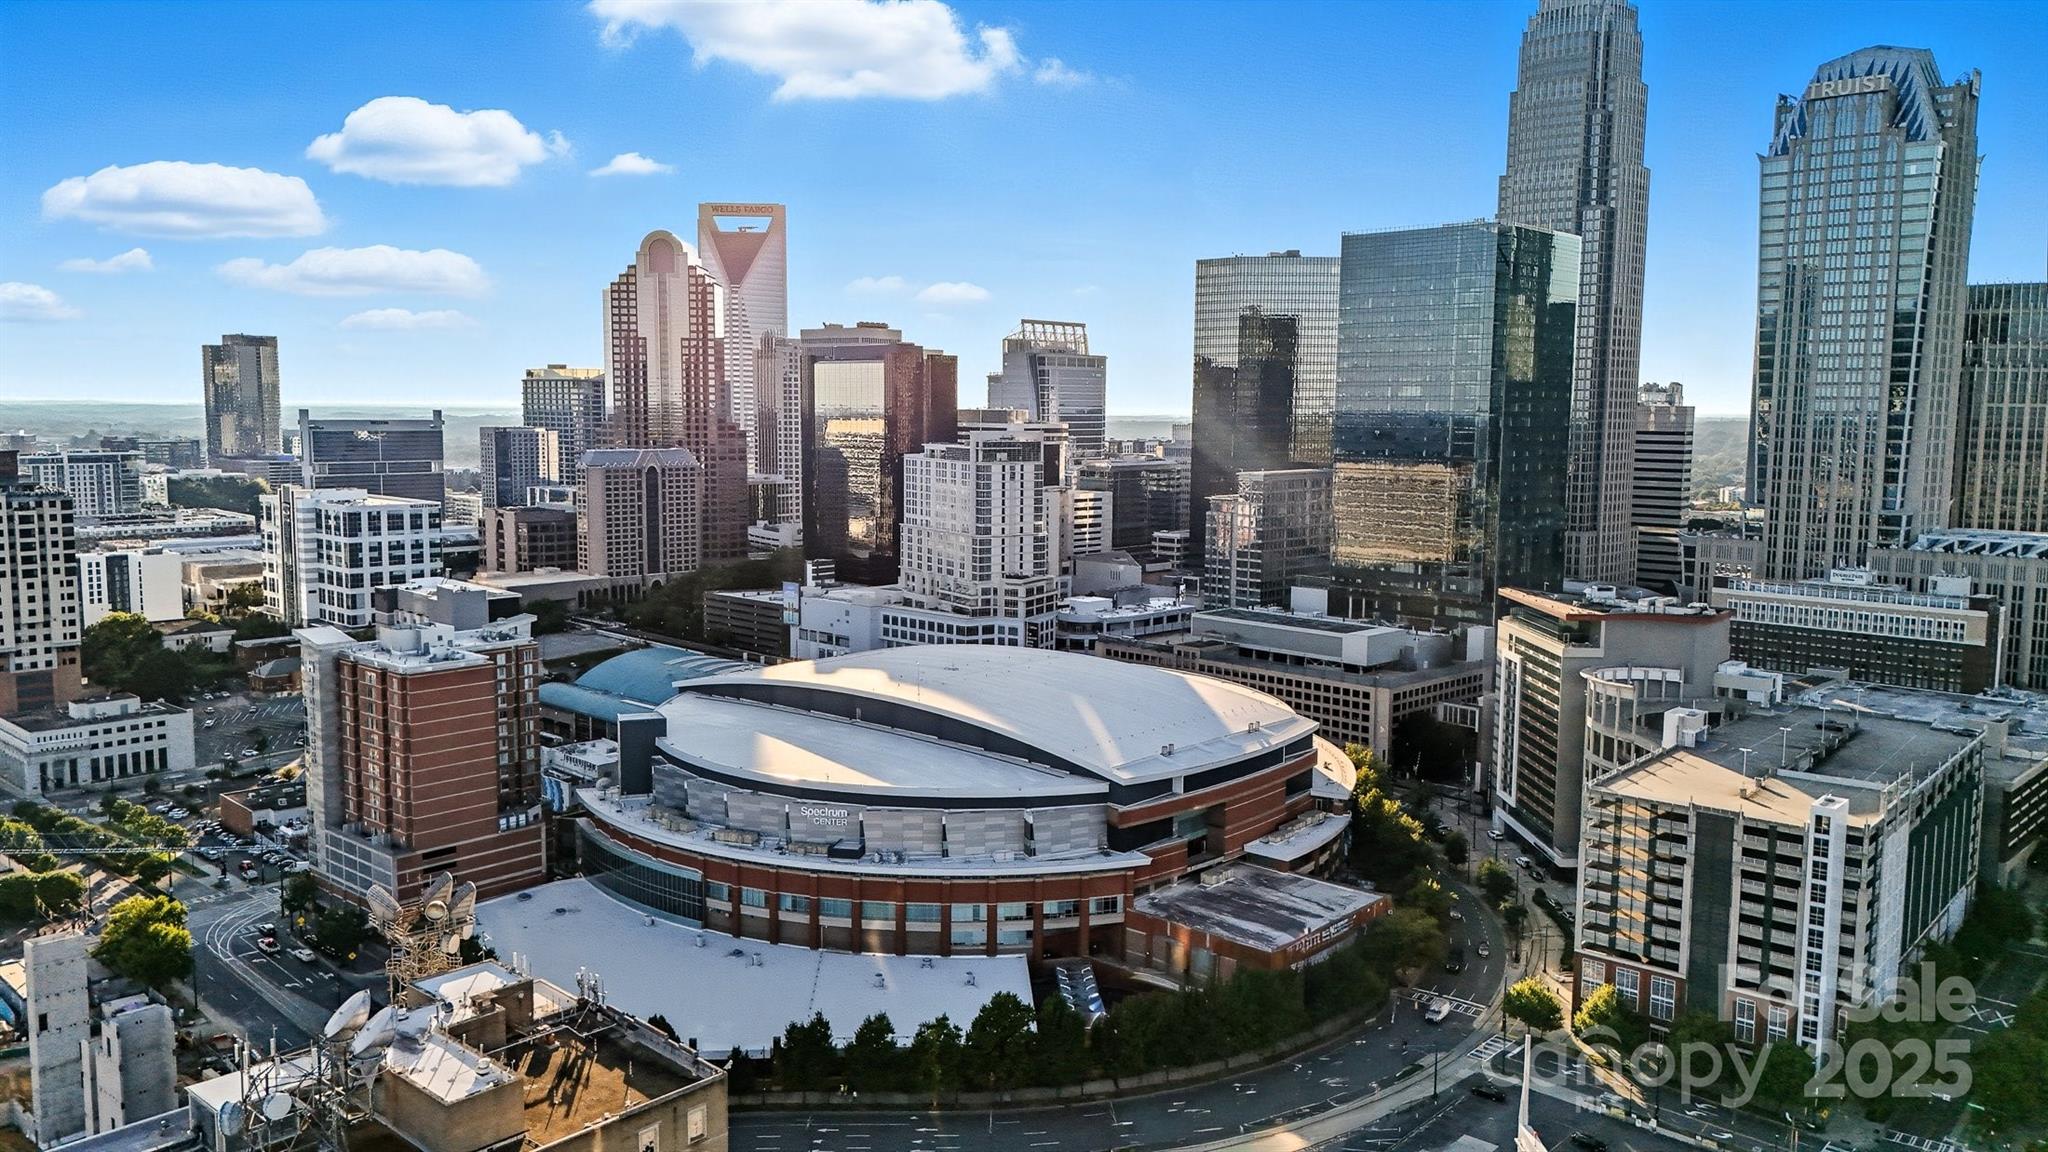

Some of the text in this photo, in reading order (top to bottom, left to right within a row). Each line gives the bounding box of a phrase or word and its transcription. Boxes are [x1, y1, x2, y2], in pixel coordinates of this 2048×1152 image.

[1808, 74, 1891, 100] TRUIST
[711, 205, 774, 214] WELLS FARGO
[800, 806, 848, 818] Spectrum
[813, 817, 848, 826] CENTER
